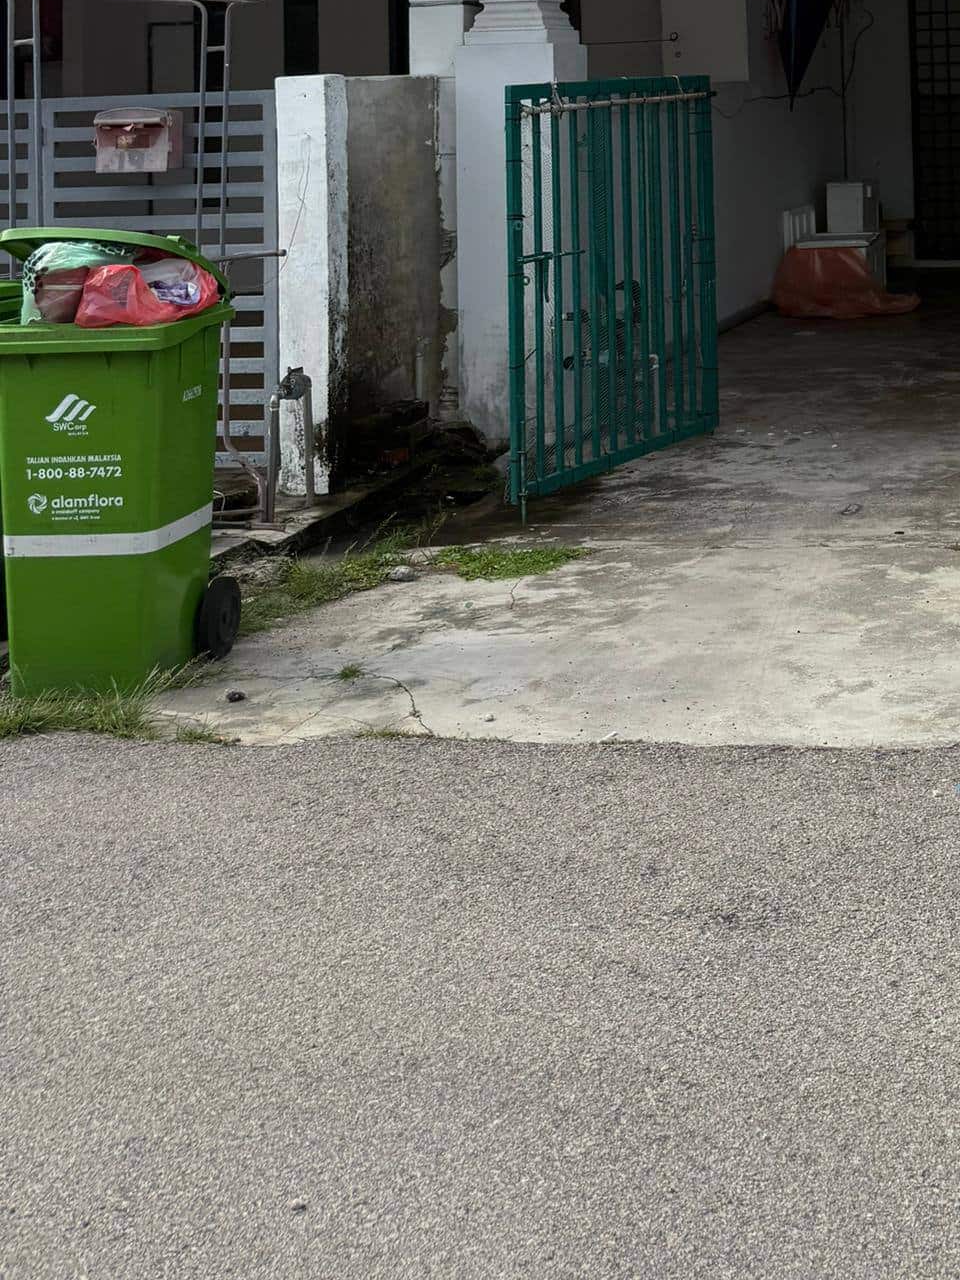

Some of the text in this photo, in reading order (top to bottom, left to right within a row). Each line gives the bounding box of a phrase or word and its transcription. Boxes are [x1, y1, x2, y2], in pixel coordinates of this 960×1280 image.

[26, 454, 122, 464] TALIAN INDAHKAN MALAYSIA
[25, 466, 122, 480] 1-800-88-7472
[51, 494, 123, 508] alamflora
